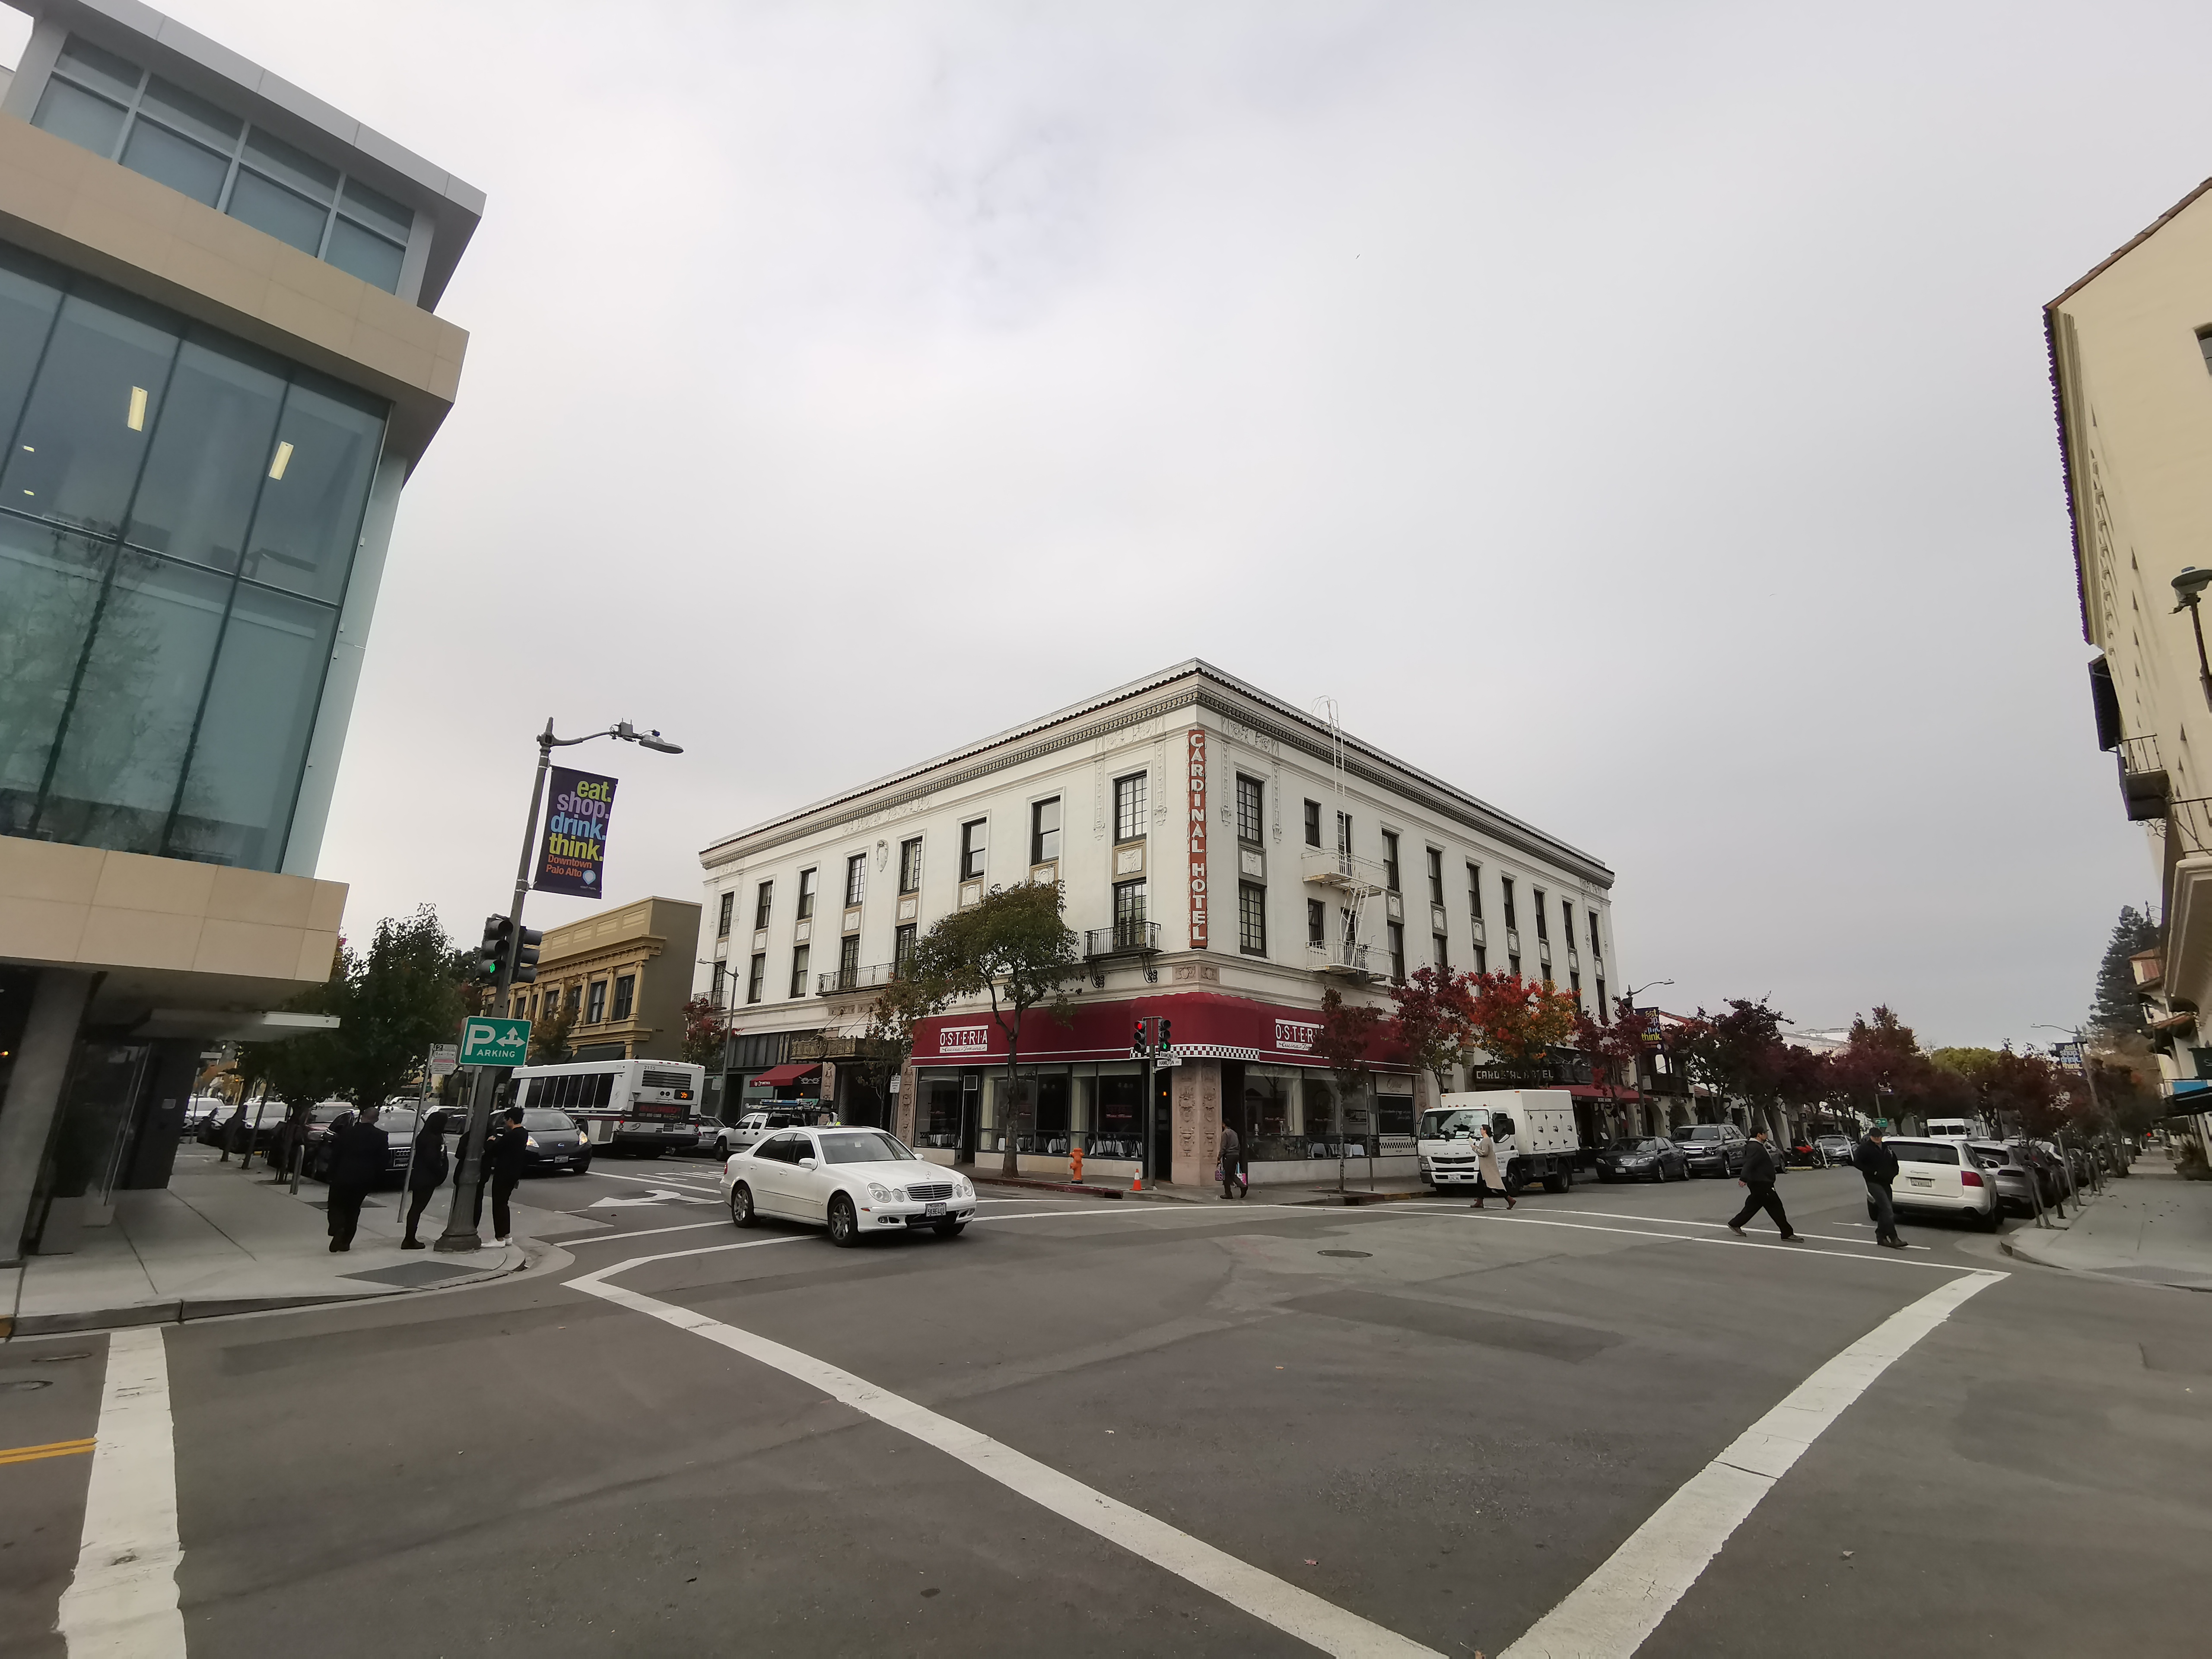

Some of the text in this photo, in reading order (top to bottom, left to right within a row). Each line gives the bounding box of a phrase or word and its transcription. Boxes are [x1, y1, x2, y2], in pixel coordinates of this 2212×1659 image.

[557, 791, 610, 819] shop.
[577, 781, 611, 803] eat.
[551, 811, 606, 840] drink.
[1190, 734, 1206, 940] CARDINAL HOTEL
[548, 854, 592, 868] Downtown
[549, 833, 604, 861] think.
[546, 864, 582, 877] Palo Alto
